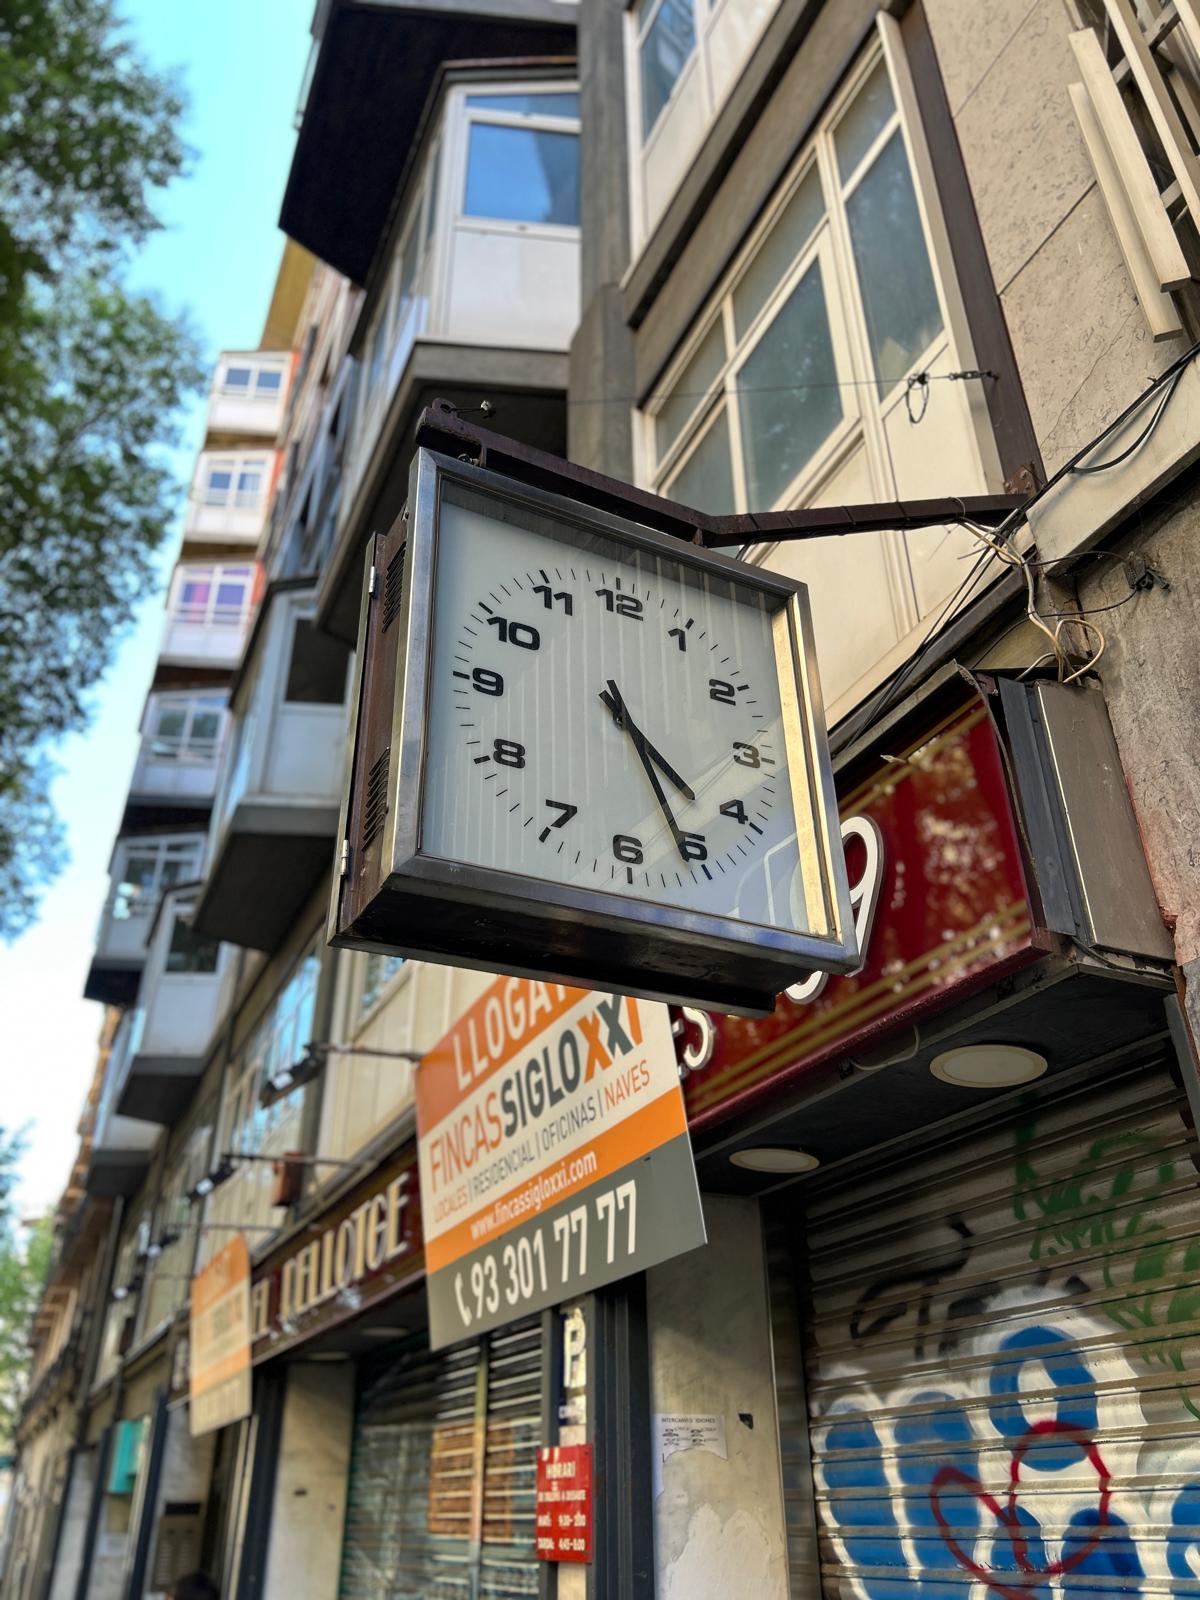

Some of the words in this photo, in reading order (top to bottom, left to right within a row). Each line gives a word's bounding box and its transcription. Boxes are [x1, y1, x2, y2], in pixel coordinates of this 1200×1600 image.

[532, 585, 574, 616] 11
[595, 588, 644, 621] 12
[486, 616, 541, 651] 10
[668, 627, 687, 652] 1
[472, 667, 504, 697] 9
[708, 679, 737, 706] 2
[492, 738, 526, 769] 8
[732, 741, 761, 769] 3
[545, 799, 578, 829] 7
[719, 799, 749, 825] 4
[612, 834, 644, 865] 6
[472, 1139, 534, 1198] RESIDENCIAL
[541, 1096, 597, 1152] OFICINAS
[603, 1059, 650, 1112] NAVES
[471, 1254, 500, 1319] 93
[503, 1228, 548, 1306] 301
[553, 1204, 588, 1283] 77
[595, 1179, 637, 1264] 77
